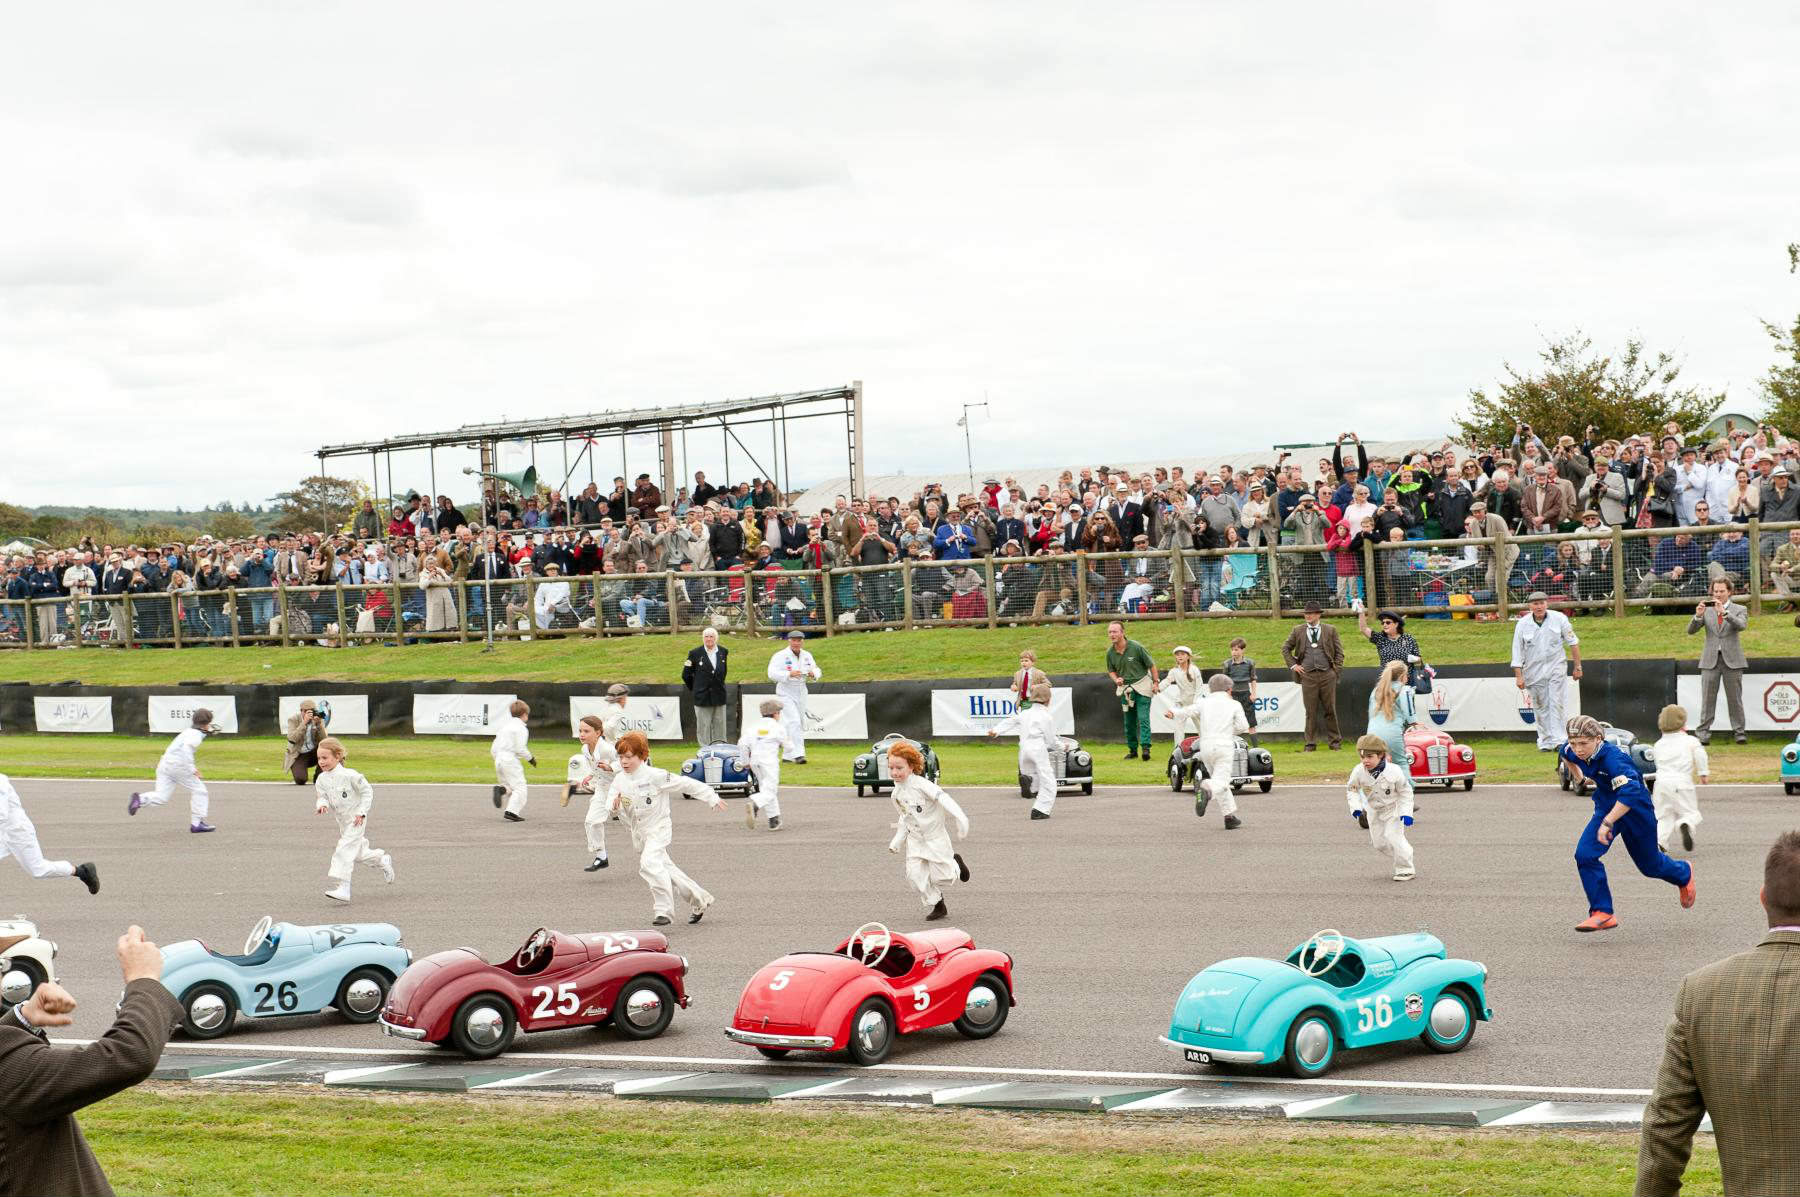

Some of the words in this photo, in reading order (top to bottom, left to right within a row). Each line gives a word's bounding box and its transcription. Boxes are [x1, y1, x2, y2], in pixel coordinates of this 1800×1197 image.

[316, 925, 358, 949] 26
[591, 932, 639, 955] 25
[768, 970, 795, 991] 5
[254, 980, 299, 1014] 26
[532, 981, 581, 1019] 25
[911, 984, 931, 1011] 5
[1356, 993, 1393, 1033] 56
